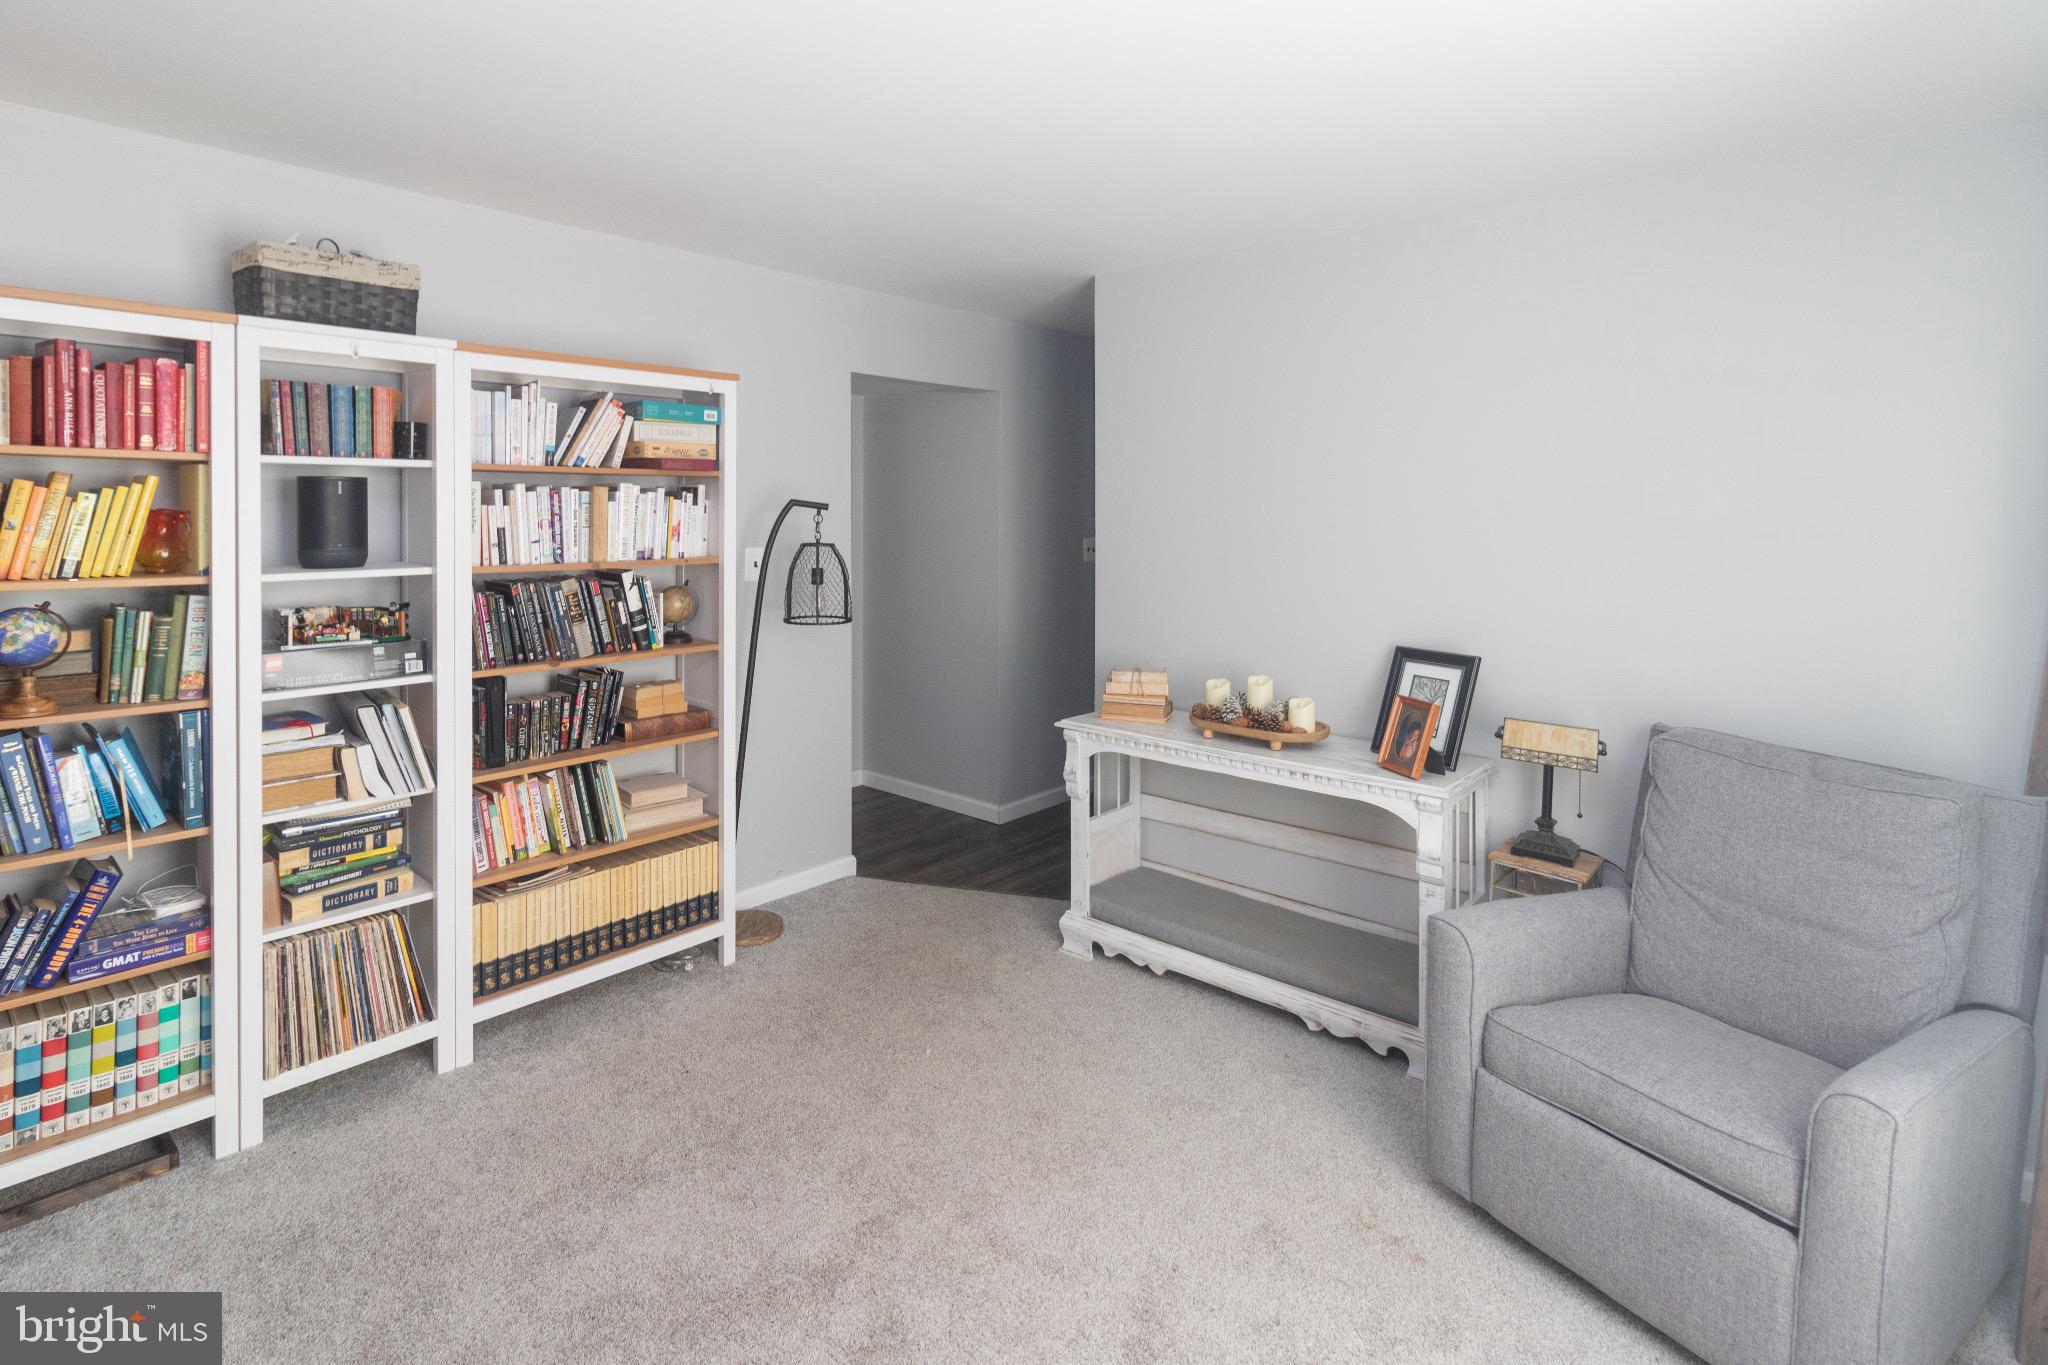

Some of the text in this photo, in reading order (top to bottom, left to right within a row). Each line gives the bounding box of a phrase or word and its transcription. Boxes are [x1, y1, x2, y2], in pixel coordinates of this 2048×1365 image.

[64, 390, 73, 411] ANN
[188, 607, 207, 657] BIG VEGAN
[528, 614, 538, 634] GOOD
[24, 786, 34, 802] TALES
[31, 812, 41, 830] POEMS
[343, 825, 382, 837] PSYCHOLOGY
[312, 840, 363, 858] DICTIONARY
[297, 883, 314, 893] SPORT
[329, 871, 362, 884] MANAGEMENT
[325, 888, 375, 907] DICTIONARY
[5, 927, 25, 947] JASON
[38, 903, 70, 952] LEWIS BLACK
[46, 903, 97, 972] THE 4-HOUR BODY
[145, 927, 158, 935] LIFE
[126, 937, 140, 945] WERE
[142, 933, 157, 941] BORN
[76, 965, 98, 974] KAPLAN
[102, 951, 141, 969] GMAT
[142, 945, 170, 955] PREMIER
